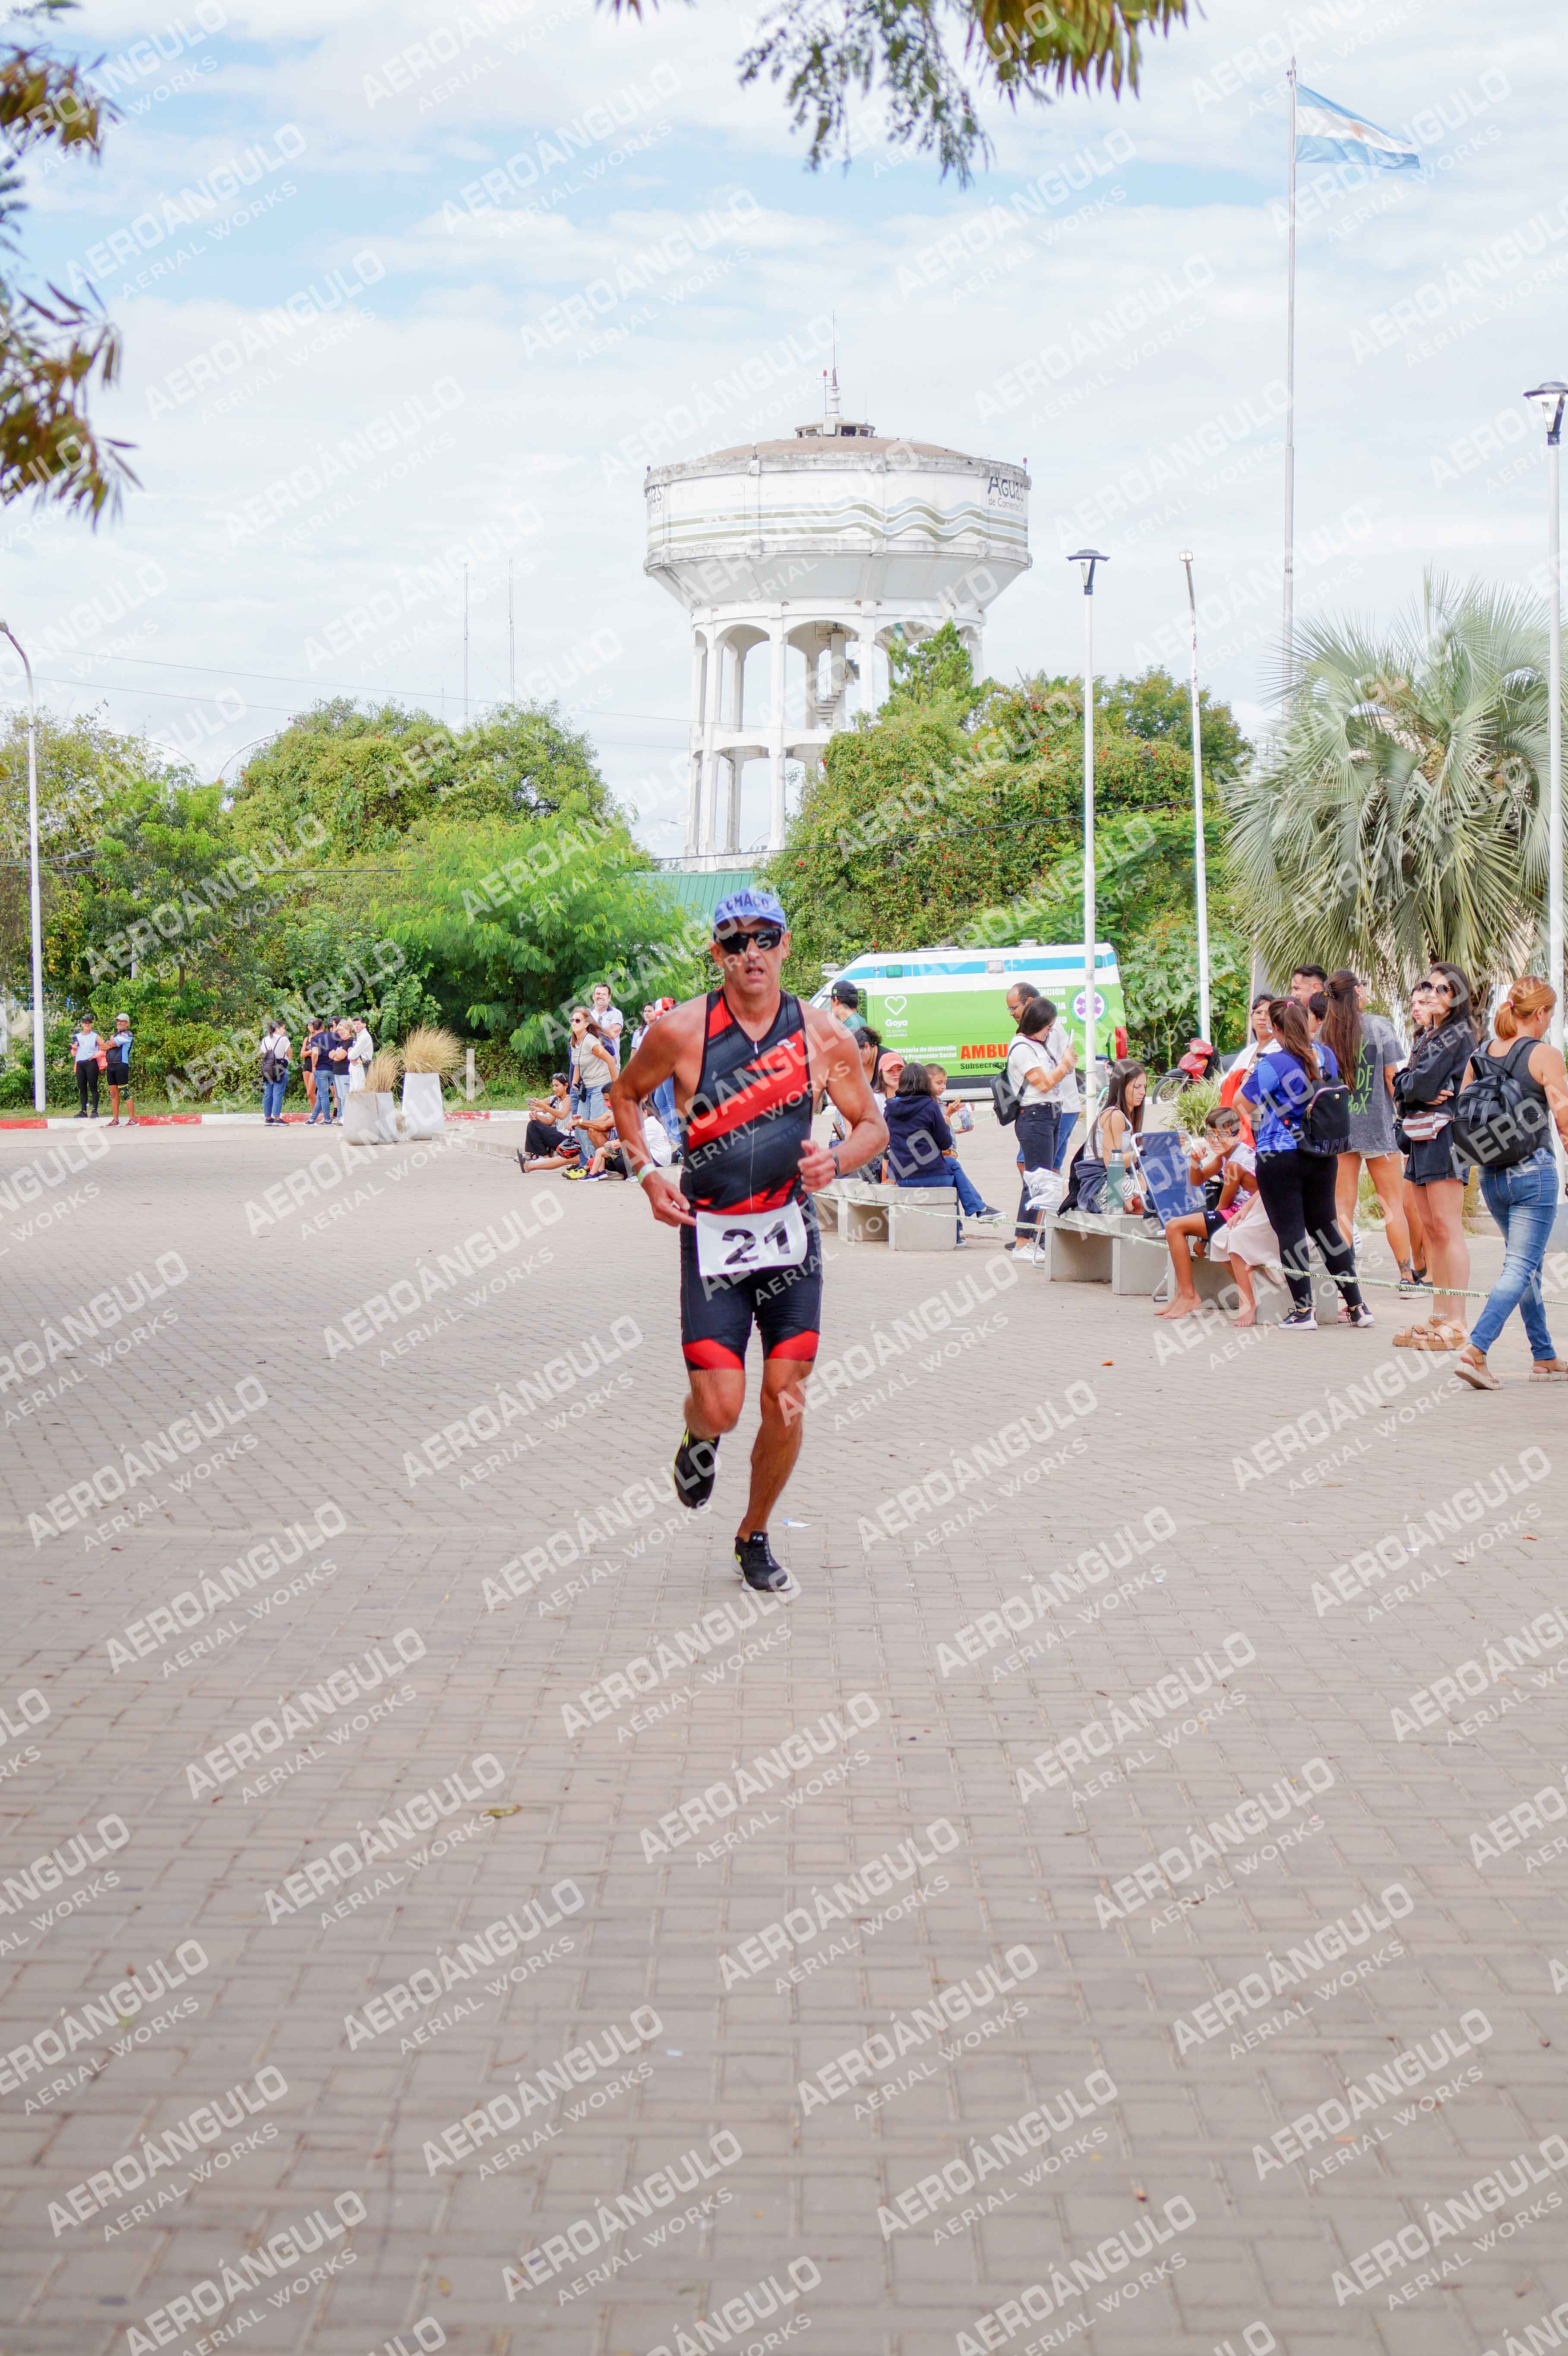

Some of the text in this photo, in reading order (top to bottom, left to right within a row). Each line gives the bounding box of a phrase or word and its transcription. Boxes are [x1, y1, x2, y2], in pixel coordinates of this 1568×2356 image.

[726, 893, 769, 911] CHACO
[885, 1019, 908, 1028] Goya
[961, 1043, 1008, 1059] AMBU
[722, 1219, 791, 1266] 21
